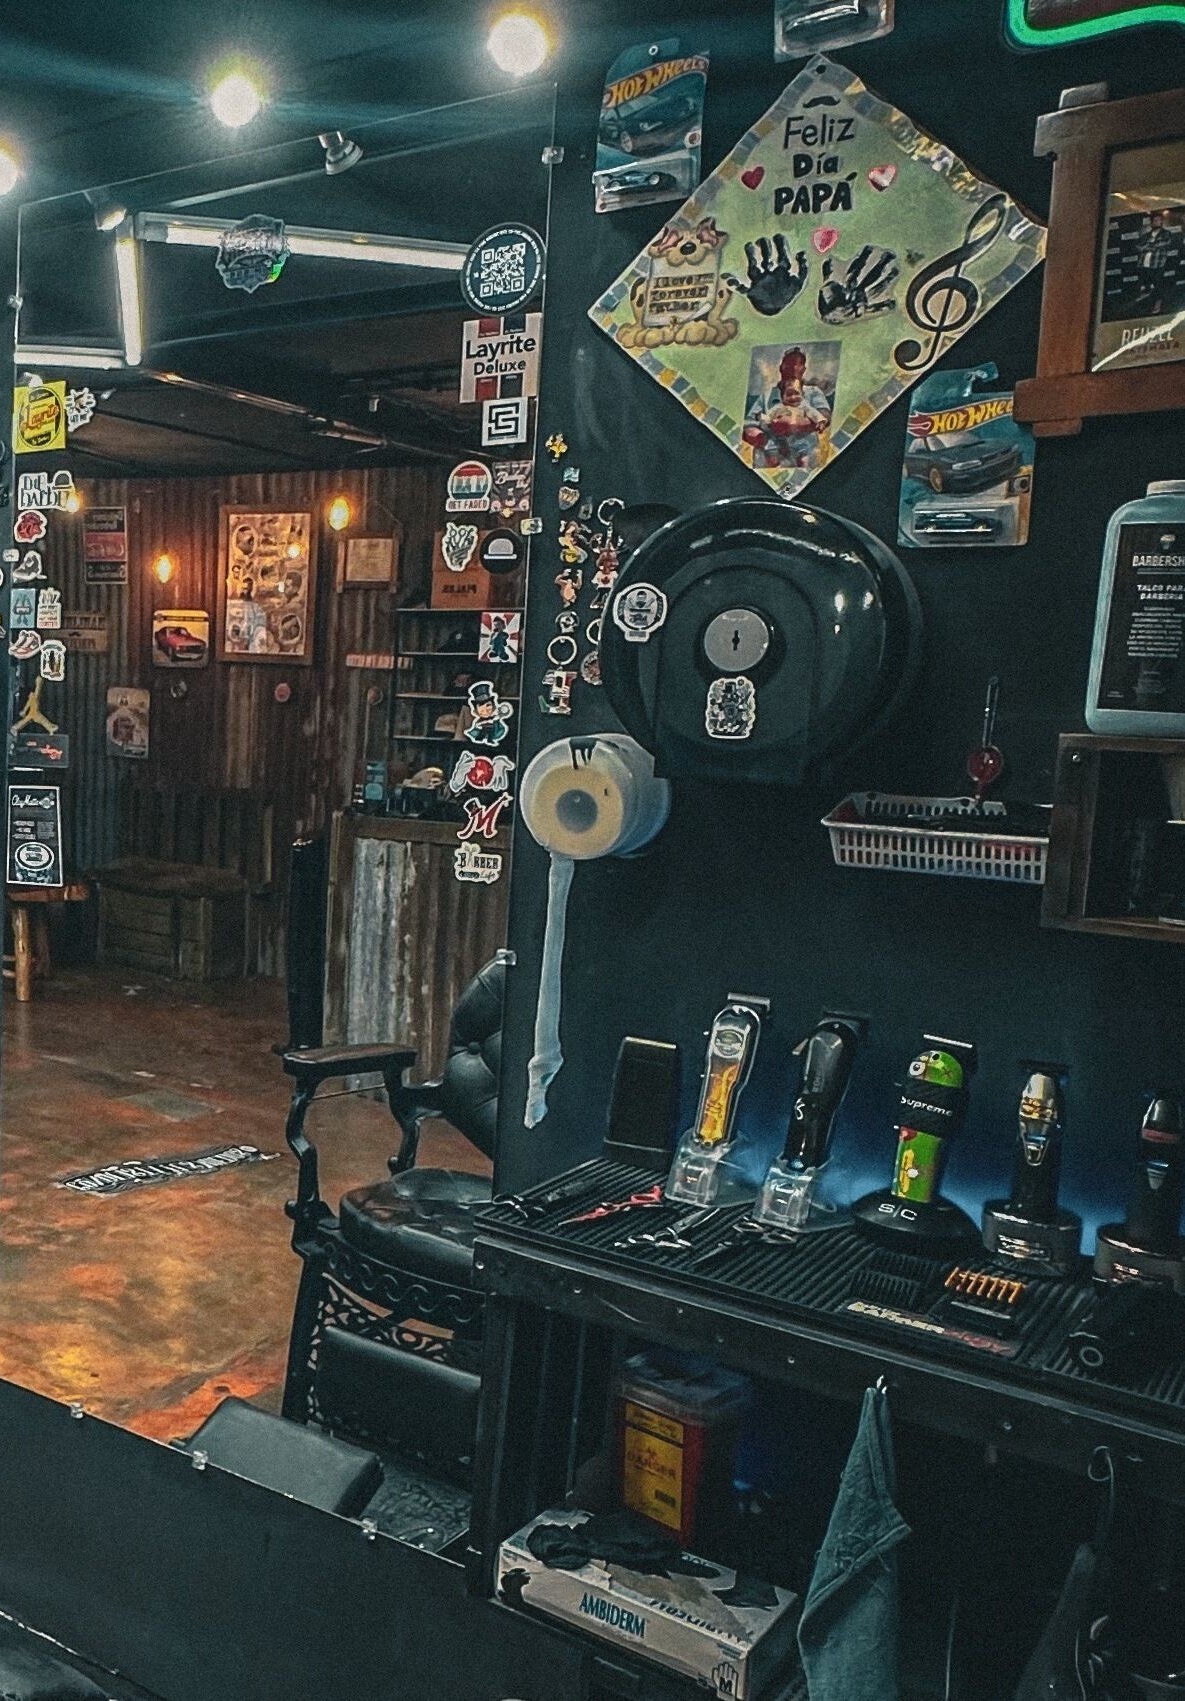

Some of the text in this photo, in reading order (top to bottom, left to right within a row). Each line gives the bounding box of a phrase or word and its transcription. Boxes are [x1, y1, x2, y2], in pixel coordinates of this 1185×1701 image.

[783, 113, 855, 149] Feliz
[792, 152, 839, 178] Día
[774, 172, 857, 216] PAPÁ
[464, 335, 537, 362] Layrite
[473, 359, 527, 375] Deluxe
[930, 409, 971, 434] HOT
[900, 1095, 953, 1117] Supreme
[578, 1591, 645, 1639] AMBIDERM
